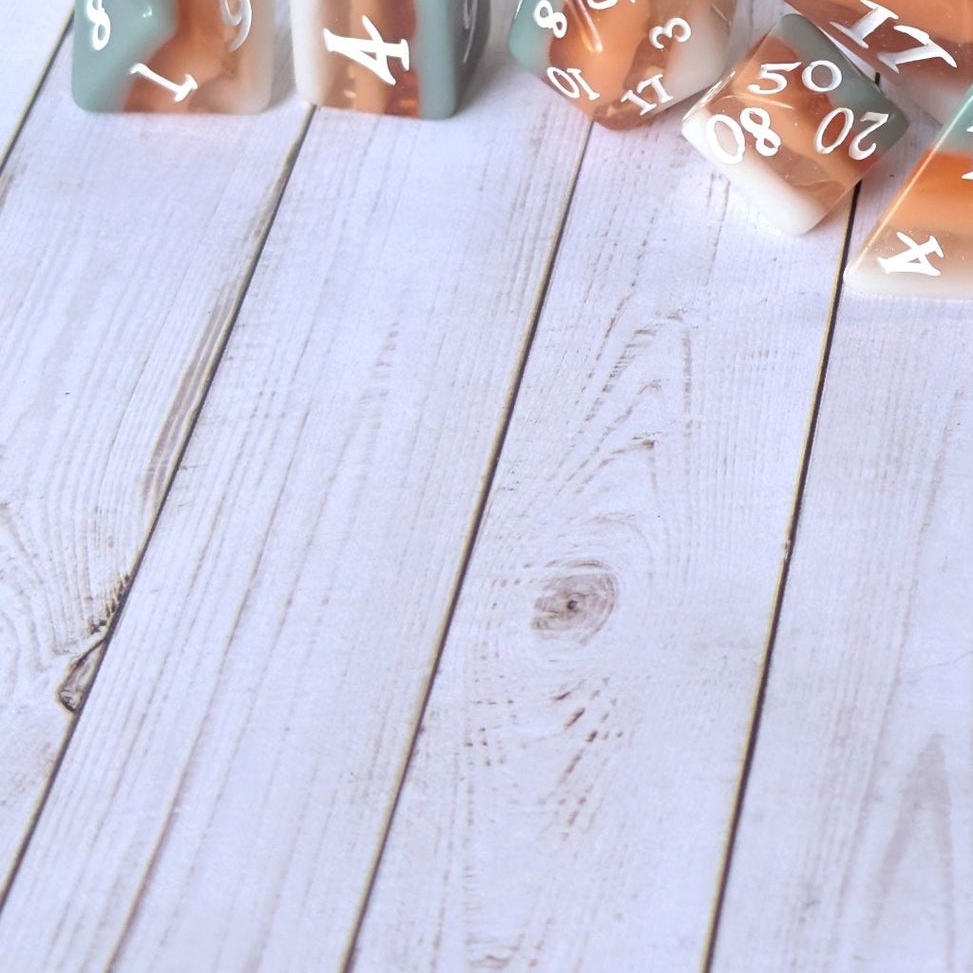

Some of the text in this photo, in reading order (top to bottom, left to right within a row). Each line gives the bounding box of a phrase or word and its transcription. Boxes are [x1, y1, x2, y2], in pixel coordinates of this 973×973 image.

[533, 0, 568, 38] 8
[649, 17, 692, 50] 3
[324, 15, 411, 86] 4
[130, 63, 198, 102] 1
[547, 66, 600, 101] 10
[748, 60, 842, 96] 50
[706, 108, 782, 164] 80
[814, 108, 889, 161] 20
[877, 232, 944, 276] 4
